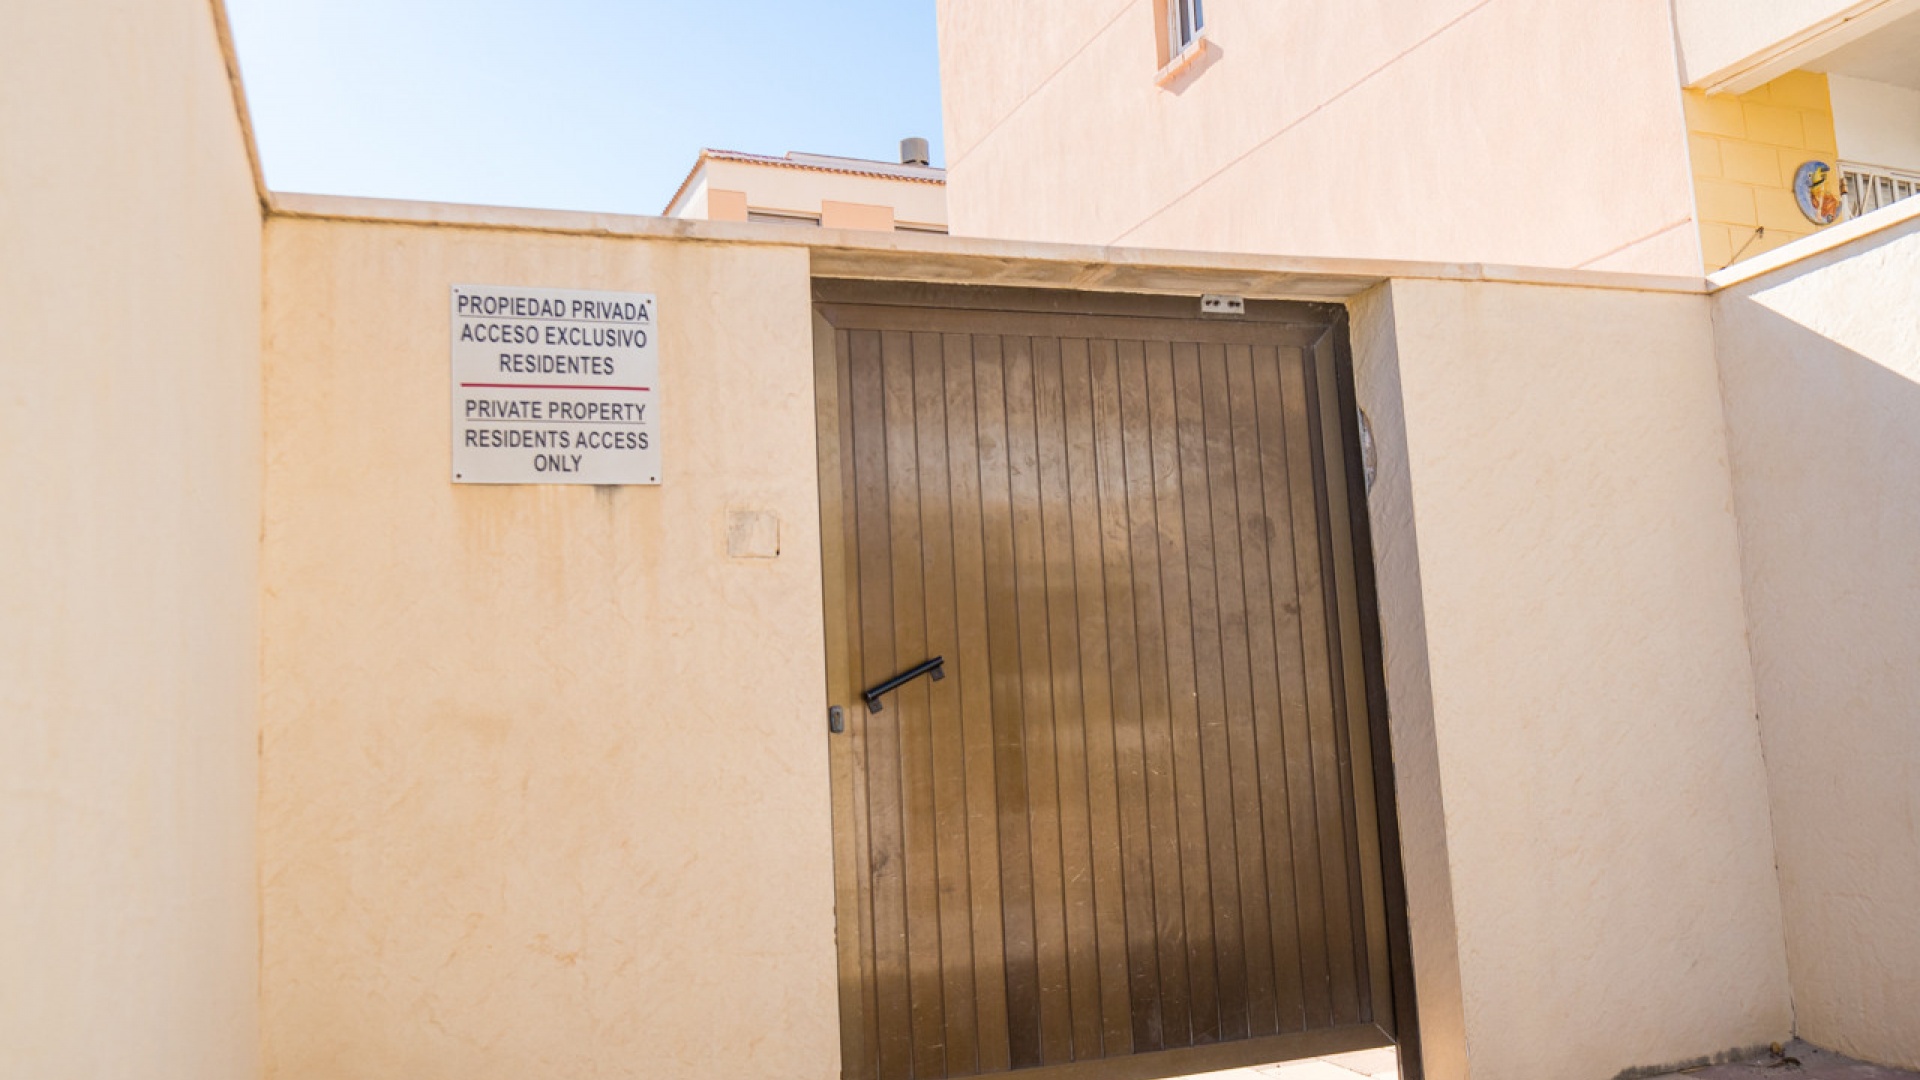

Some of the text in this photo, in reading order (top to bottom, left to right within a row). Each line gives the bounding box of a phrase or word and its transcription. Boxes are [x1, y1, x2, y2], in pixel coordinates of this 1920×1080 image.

[458, 295, 649, 321] PROPIEDAD PRIVADA
[461, 323, 647, 348] ACCESO EXCLUSIVO
[500, 354, 615, 375] RESIDENTES
[466, 400, 646, 420] PRIVATE PROPERTY
[465, 429, 649, 450] RESIDENTS ACCESS
[534, 454, 583, 472] ONLY
